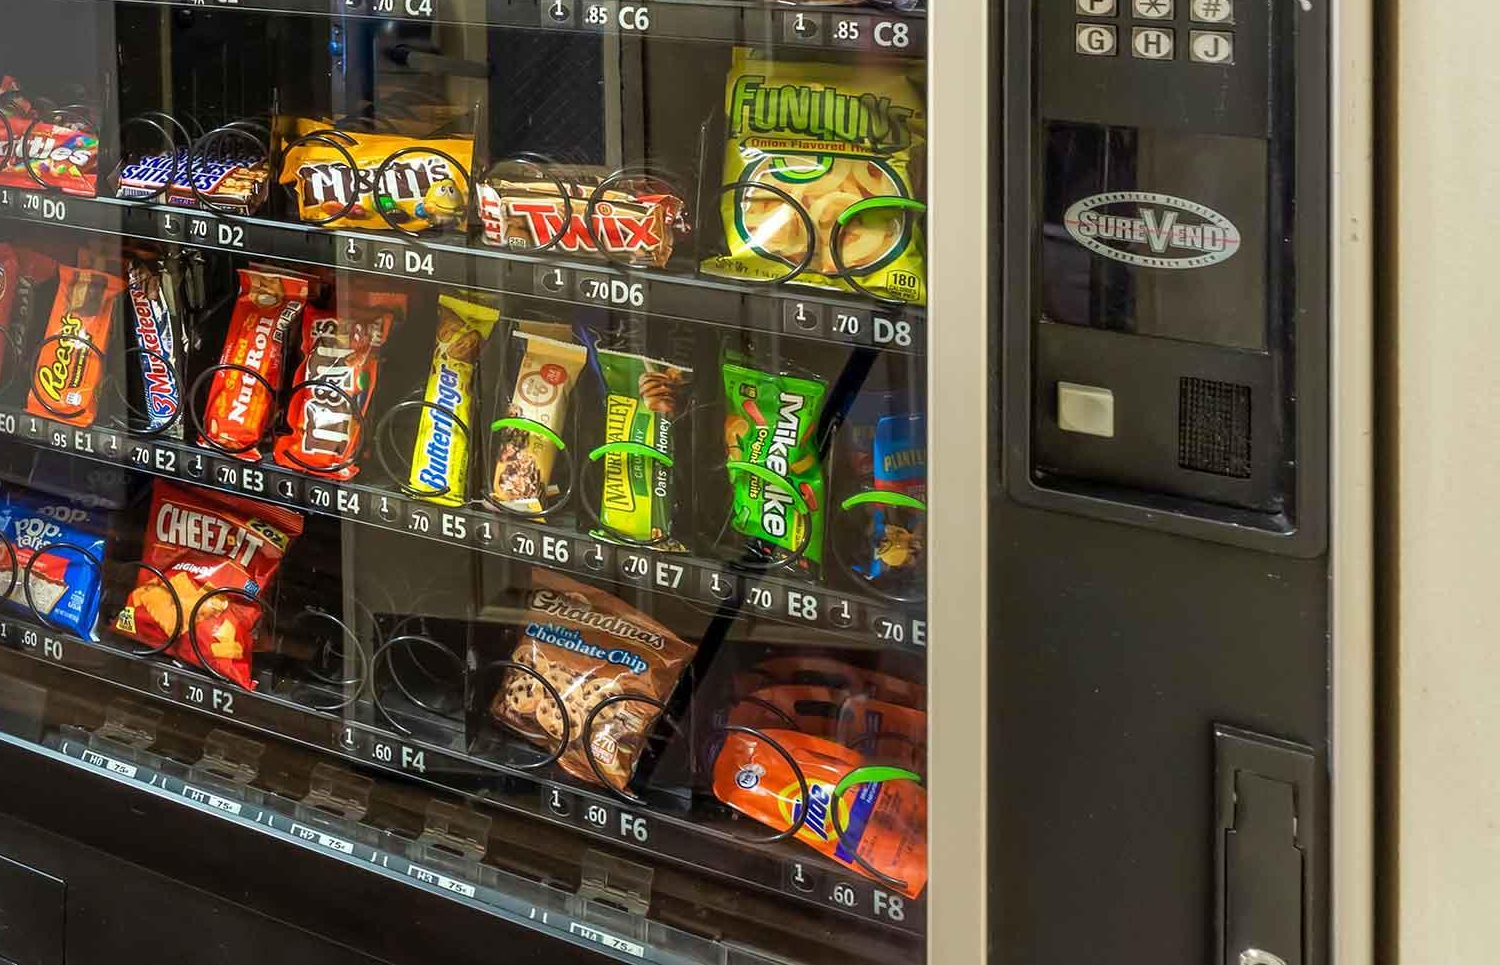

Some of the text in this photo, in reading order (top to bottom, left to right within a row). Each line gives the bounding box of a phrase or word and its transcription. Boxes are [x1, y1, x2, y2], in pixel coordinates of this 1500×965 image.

[585, 4, 608, 24] .85
[618, 6, 650, 31] C6
[874, 21, 909, 48] C8
[1087, 29, 1104, 50] G
[1144, 33, 1162, 54] H
[1203, 37, 1219, 58] J
[731, 75, 915, 154] FUNYUNS
[750, 138, 847, 152] Onion Flavored
[43, 199, 66, 220] D0
[218, 223, 244, 247] D2
[1078, 207, 1226, 253] SUREVEND
[405, 250, 435, 275] D4
[611, 279, 645, 307] D6
[891, 272, 916, 288] 180
[873, 317, 911, 346] D8
[228, 316, 274, 424] Nut Roll
[151, 397, 177, 416] 3
[419, 362, 462, 492] Butterfinger
[764, 391, 805, 477] Mike
[75, 431, 94, 453] E1
[155, 450, 175, 472] E2
[243, 469, 265, 492] E3
[655, 468, 668, 498] Oats
[337, 490, 360, 514] E4
[442, 512, 467, 539] E5
[542, 536, 569, 563] E6
[656, 561, 684, 589] E7
[787, 591, 818, 621] E8
[44, 637, 63, 660] F0
[525, 622, 649, 675] Chocolate Chip
[212, 689, 235, 714] F2
[401, 746, 427, 773] F4
[620, 812, 648, 842] F6
[873, 889, 905, 922] F8
